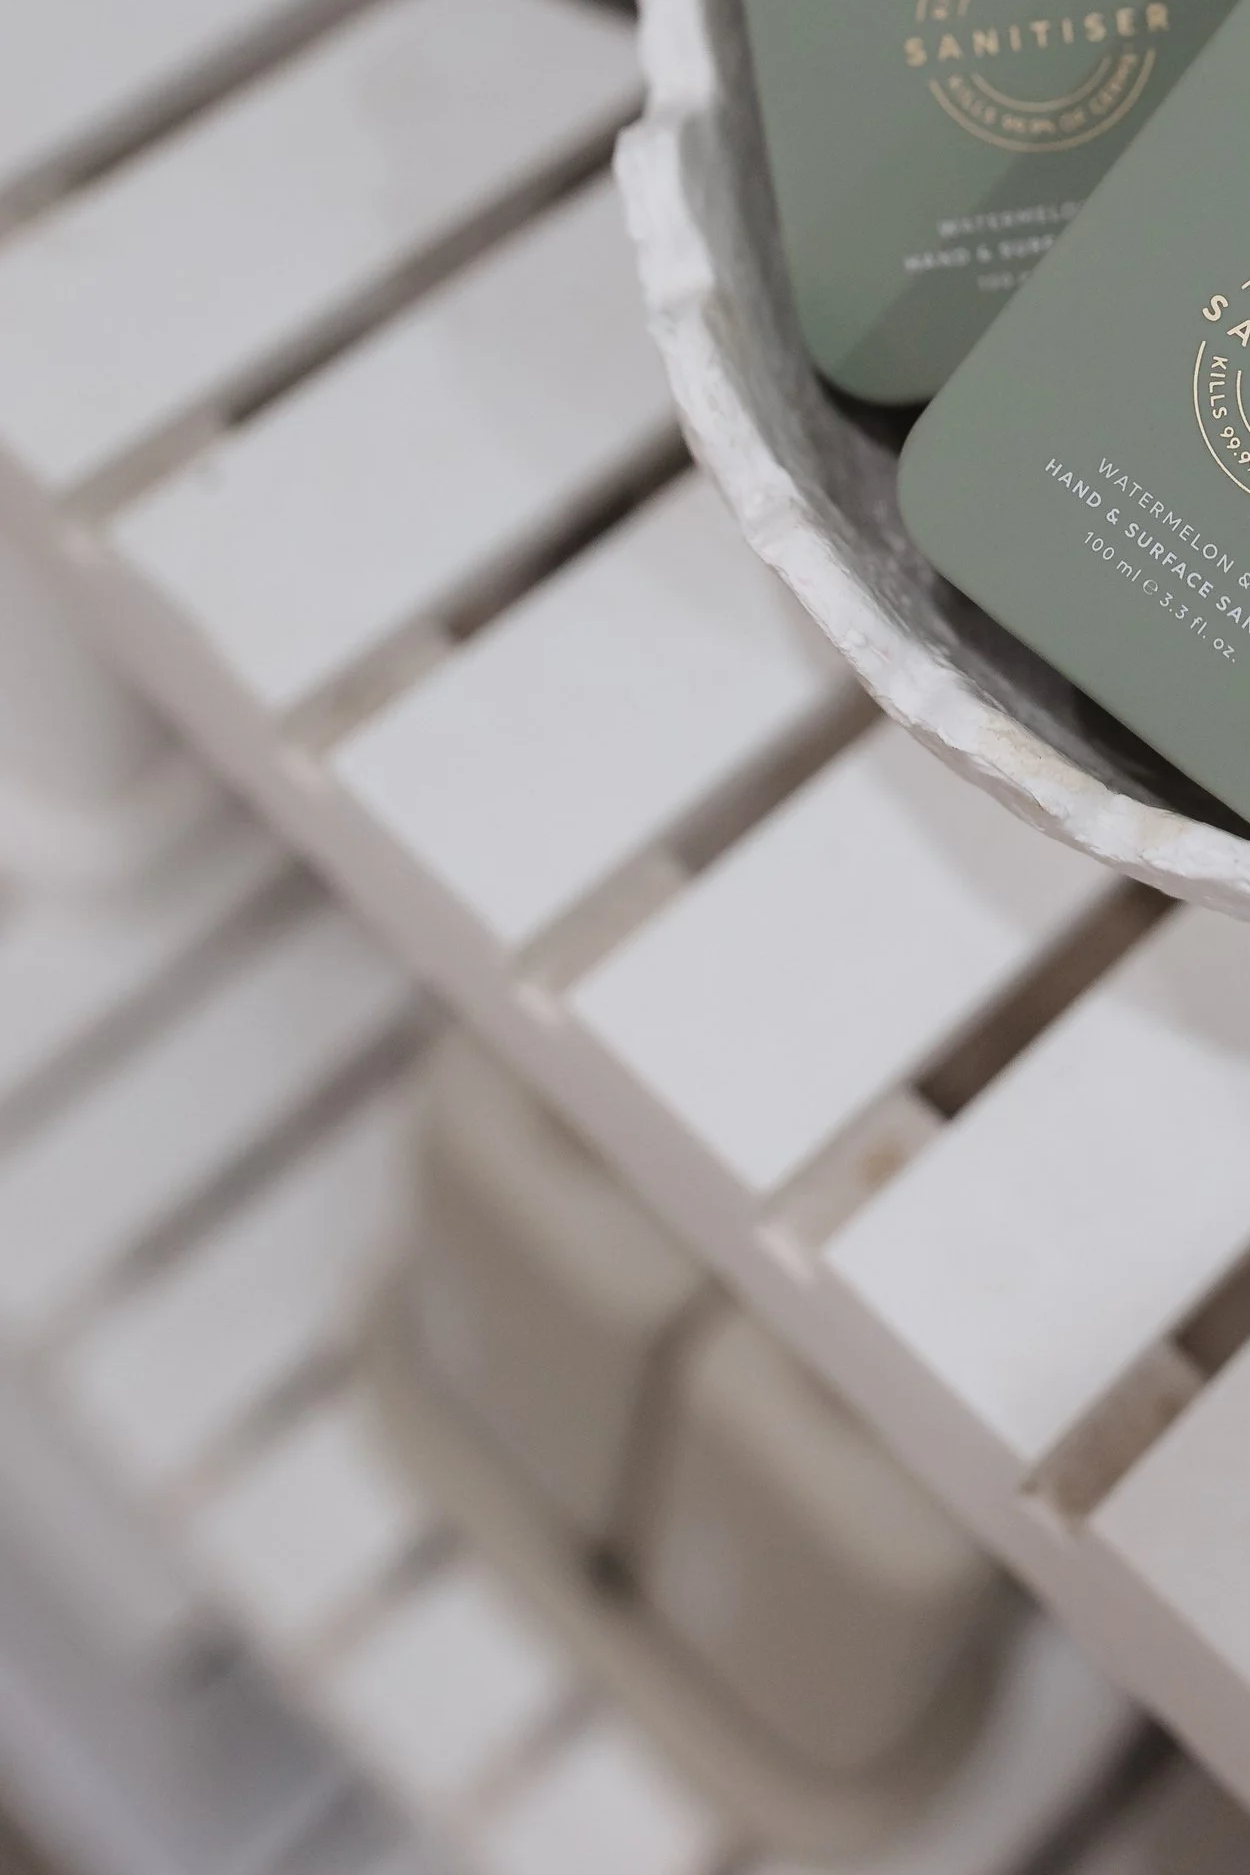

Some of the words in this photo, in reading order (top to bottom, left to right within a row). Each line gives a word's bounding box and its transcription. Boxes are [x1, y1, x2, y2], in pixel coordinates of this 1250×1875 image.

[904, 2, 1169, 67] SANITISER
[1208, 355, 1229, 420] KILLS
[1044, 458, 1102, 508] HAND
[1106, 508, 1120, 526] &
[1124, 522, 1214, 599] SURFACE
[1098, 457, 1235, 574] WATERMELON
[1083, 531, 1115, 561] 100
[1116, 560, 1142, 582] ml
[1160, 591, 1189, 620] 3.3
[1190, 616, 1208, 639] fl.
[1213, 637, 1236, 664] oz.
